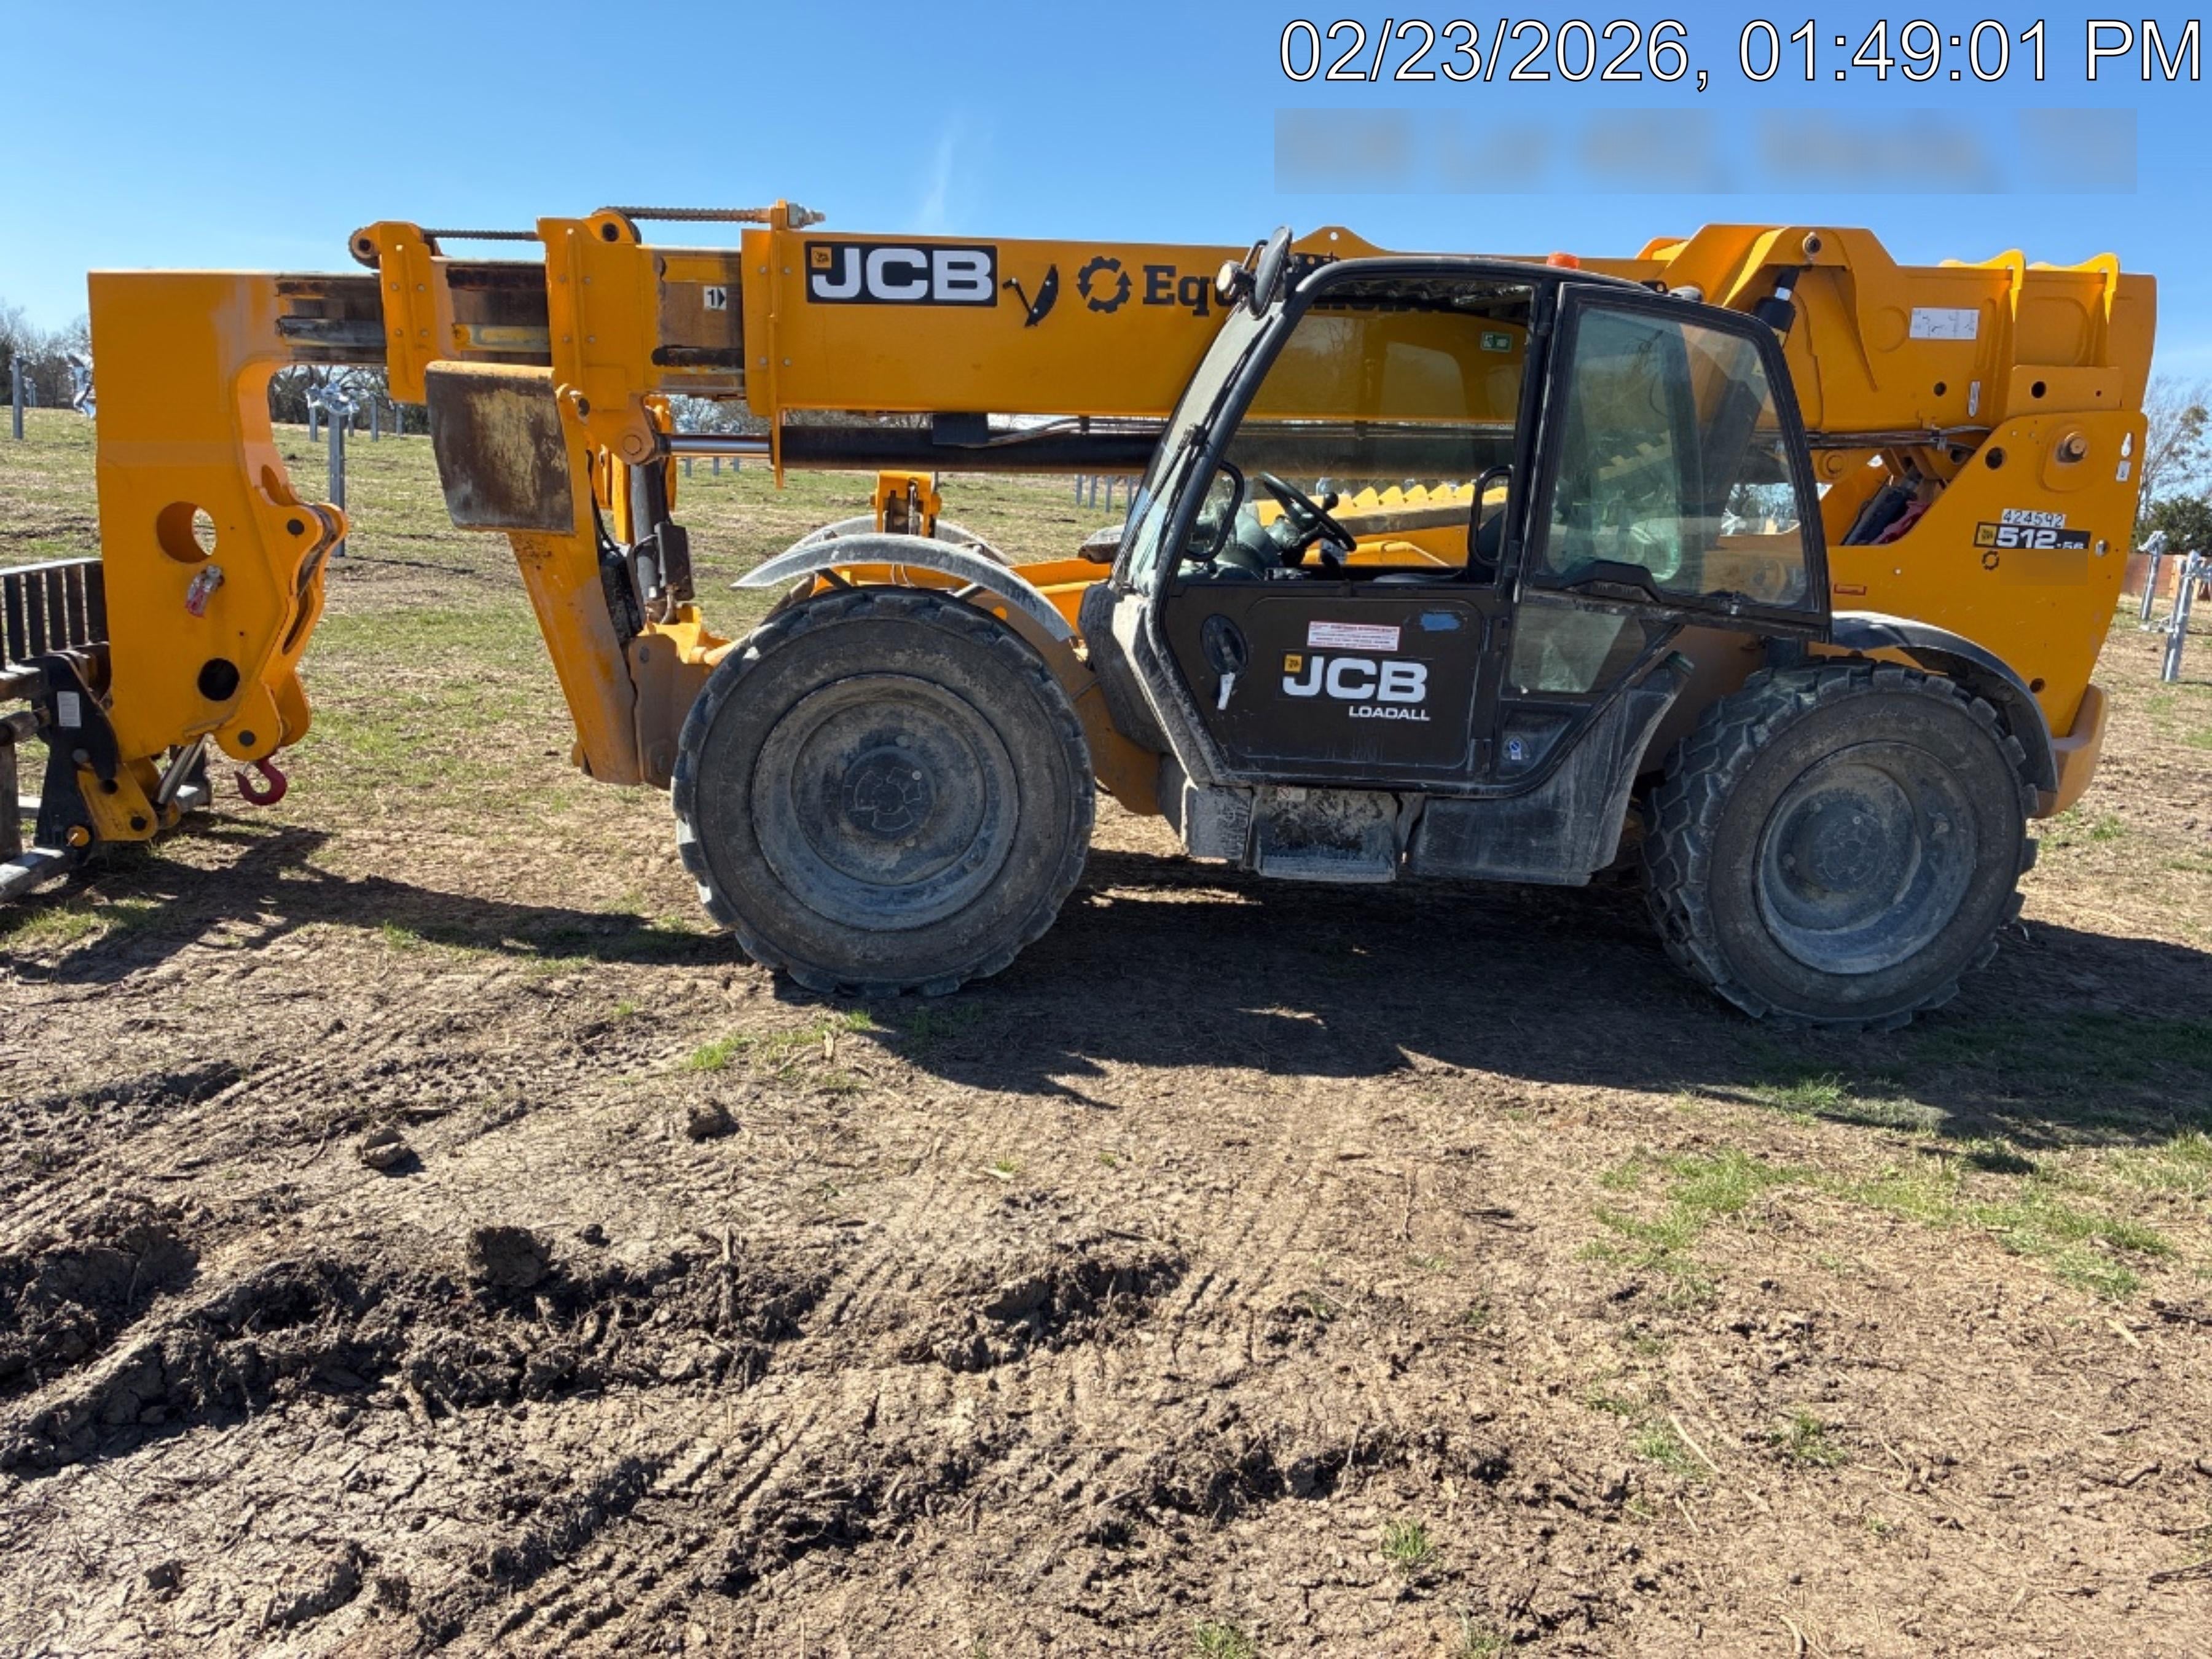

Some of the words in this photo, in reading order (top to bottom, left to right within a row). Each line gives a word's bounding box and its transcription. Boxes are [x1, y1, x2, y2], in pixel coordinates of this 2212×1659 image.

[812, 247, 993, 300] JCB
[1282, 656, 1428, 702] JCB
[1349, 705, 1430, 721] LOADALL
